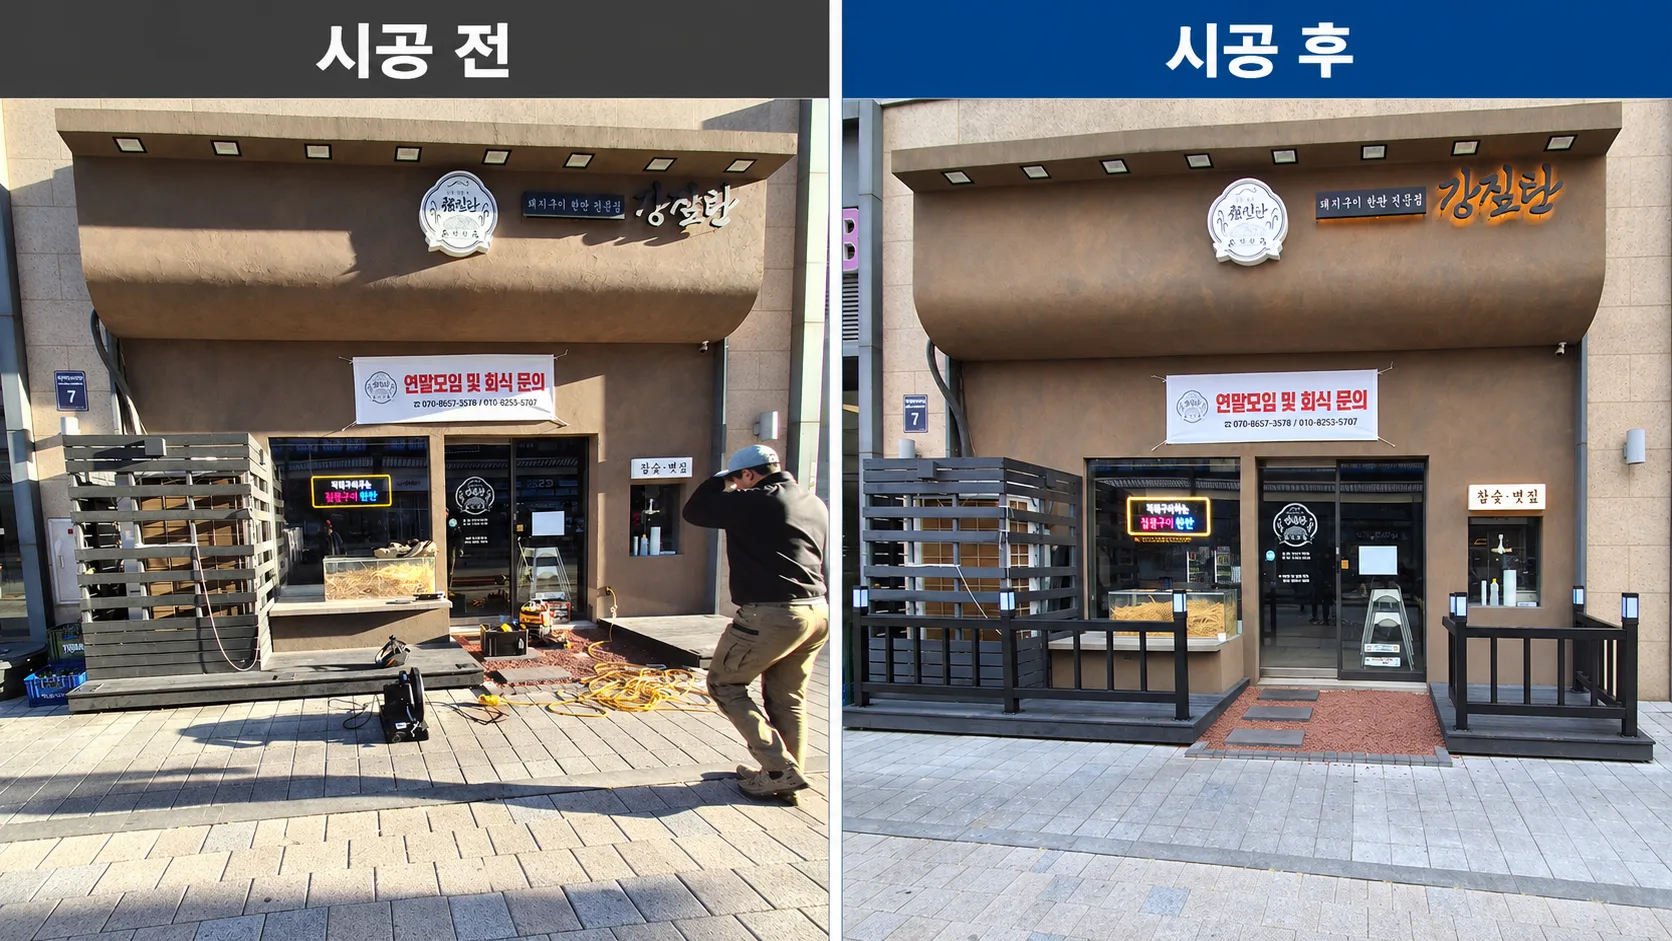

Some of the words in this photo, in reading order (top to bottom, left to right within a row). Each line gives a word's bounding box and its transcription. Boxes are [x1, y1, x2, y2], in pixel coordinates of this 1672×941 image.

[1320, 196, 1361, 211] 돼지구이
[403, 373, 463, 395] 연말모임
[466, 373, 481, 393] 및
[485, 372, 513, 393] 회식
[517, 372, 545, 393] 문의
[67, 390, 76, 403] 7
[1215, 392, 1276, 414] 연말모임
[1281, 391, 1296, 413] 및
[1300, 390, 1332, 412] 회식
[1336, 389, 1368, 411] 문의
[911, 412, 920, 426] 7
